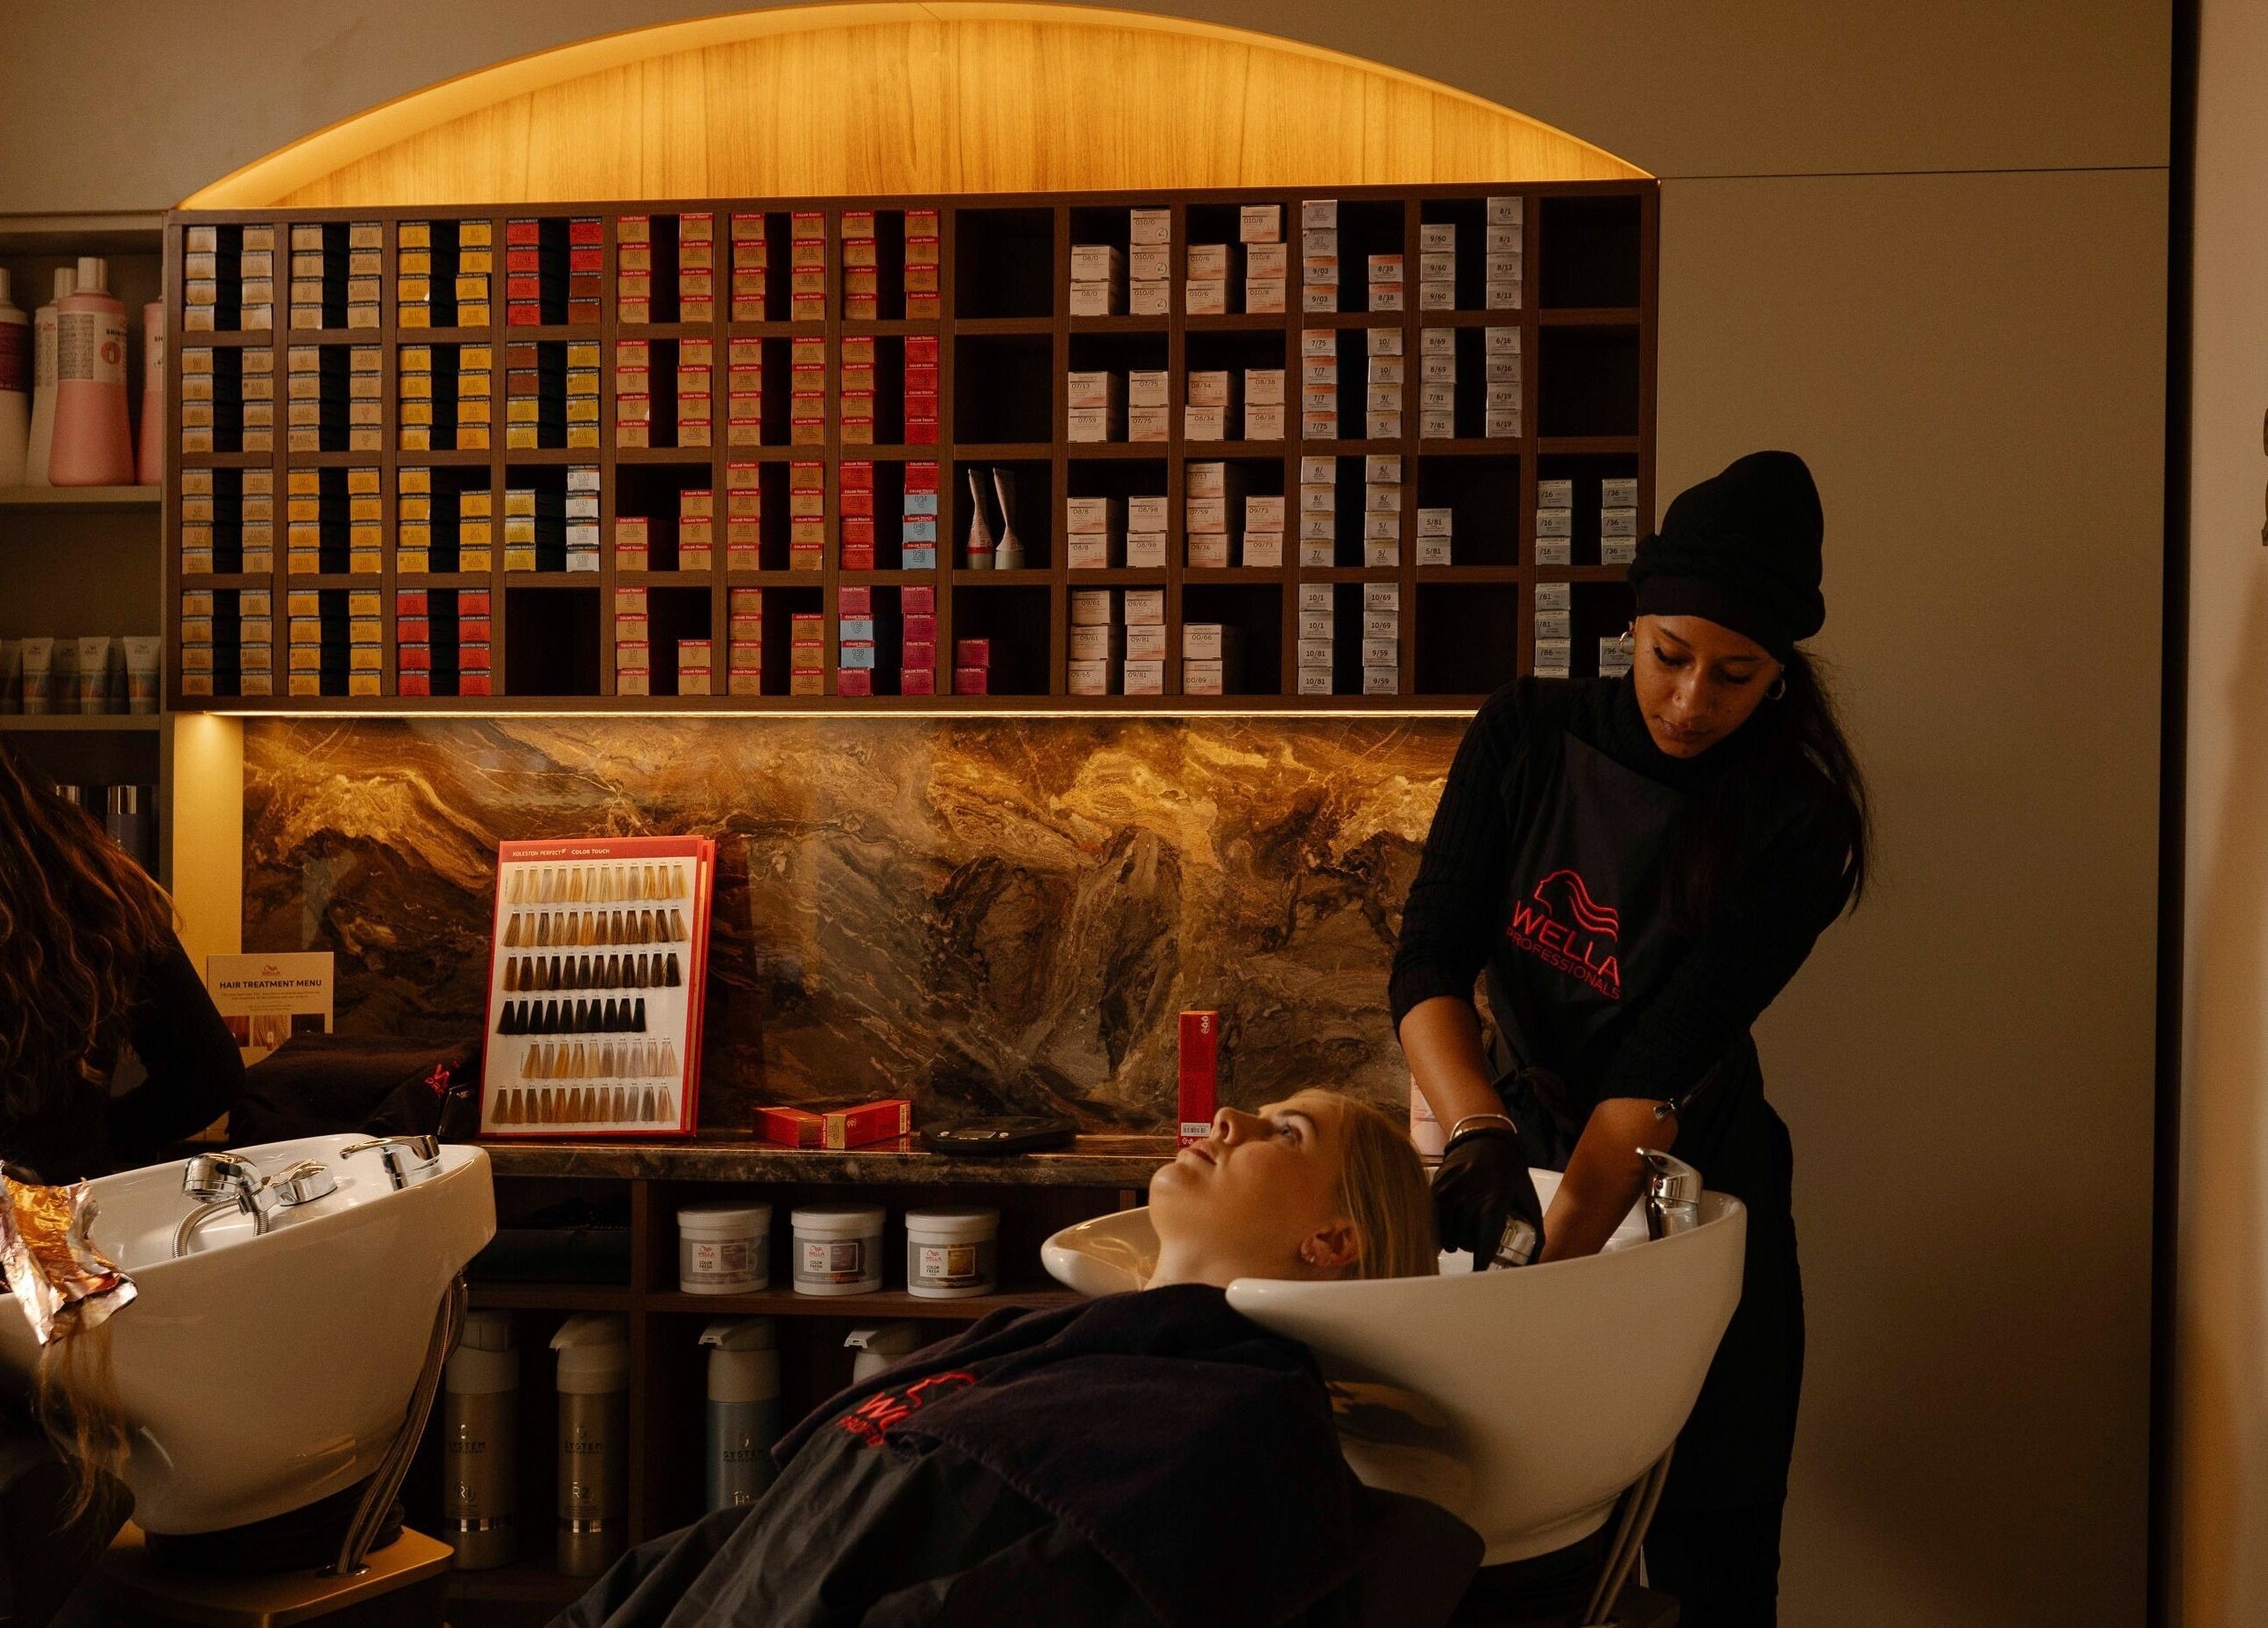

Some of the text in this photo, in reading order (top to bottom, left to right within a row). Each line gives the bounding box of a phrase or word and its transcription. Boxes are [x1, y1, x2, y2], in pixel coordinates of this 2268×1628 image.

[1505, 927, 1620, 1000] PROFESSIONALS
[1512, 899, 1620, 987] WELLA
[723, 1450, 763, 1458] SYSTEM
